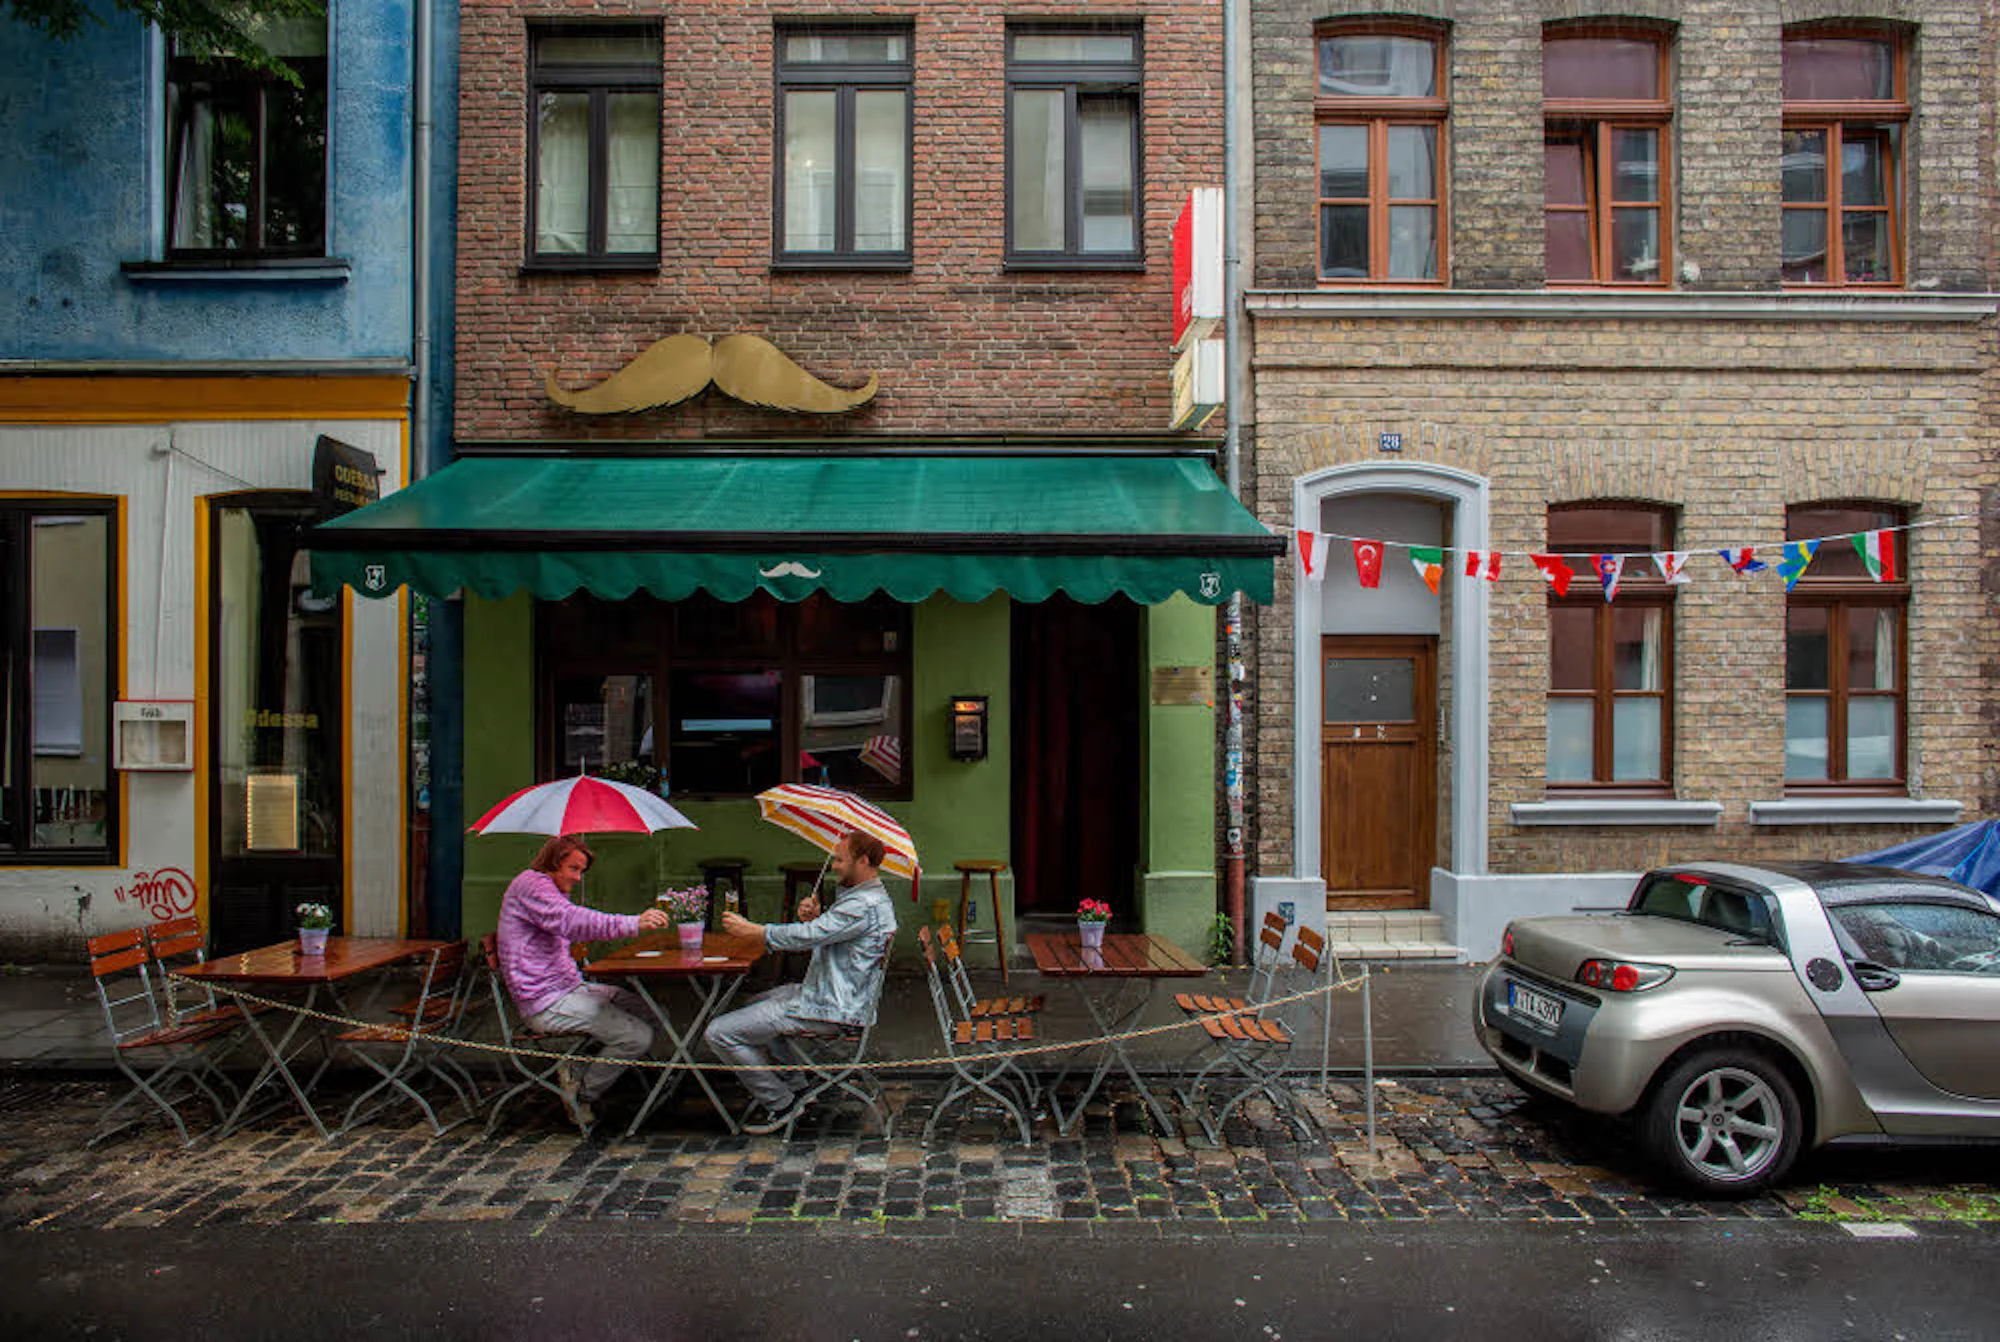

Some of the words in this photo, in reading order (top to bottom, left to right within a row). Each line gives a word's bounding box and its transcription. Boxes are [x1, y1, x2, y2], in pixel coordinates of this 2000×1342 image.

[1383, 435, 1400, 449] 28
[335, 465, 377, 491] ODESSA
[243, 707, 319, 729] Odessa
